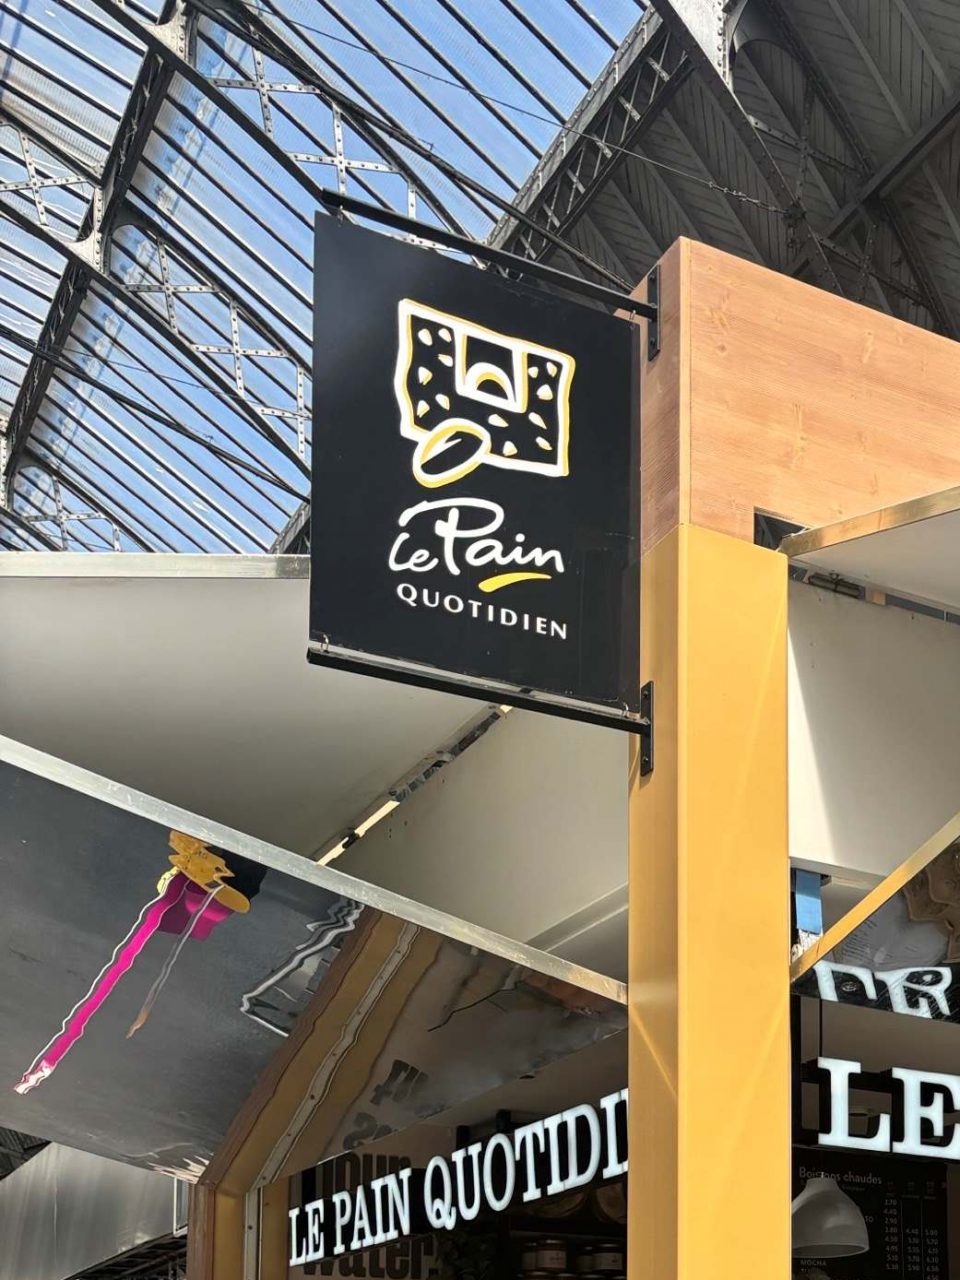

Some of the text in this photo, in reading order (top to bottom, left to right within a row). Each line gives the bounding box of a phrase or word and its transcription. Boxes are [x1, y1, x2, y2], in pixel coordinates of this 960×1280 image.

[399, 497, 565, 576] Pain
[396, 583, 568, 641] QUOTIDIEN
[289, 1088, 628, 1267] LE PAIN QUOTIDI
[843, 1171, 882, 1185] chaudes
